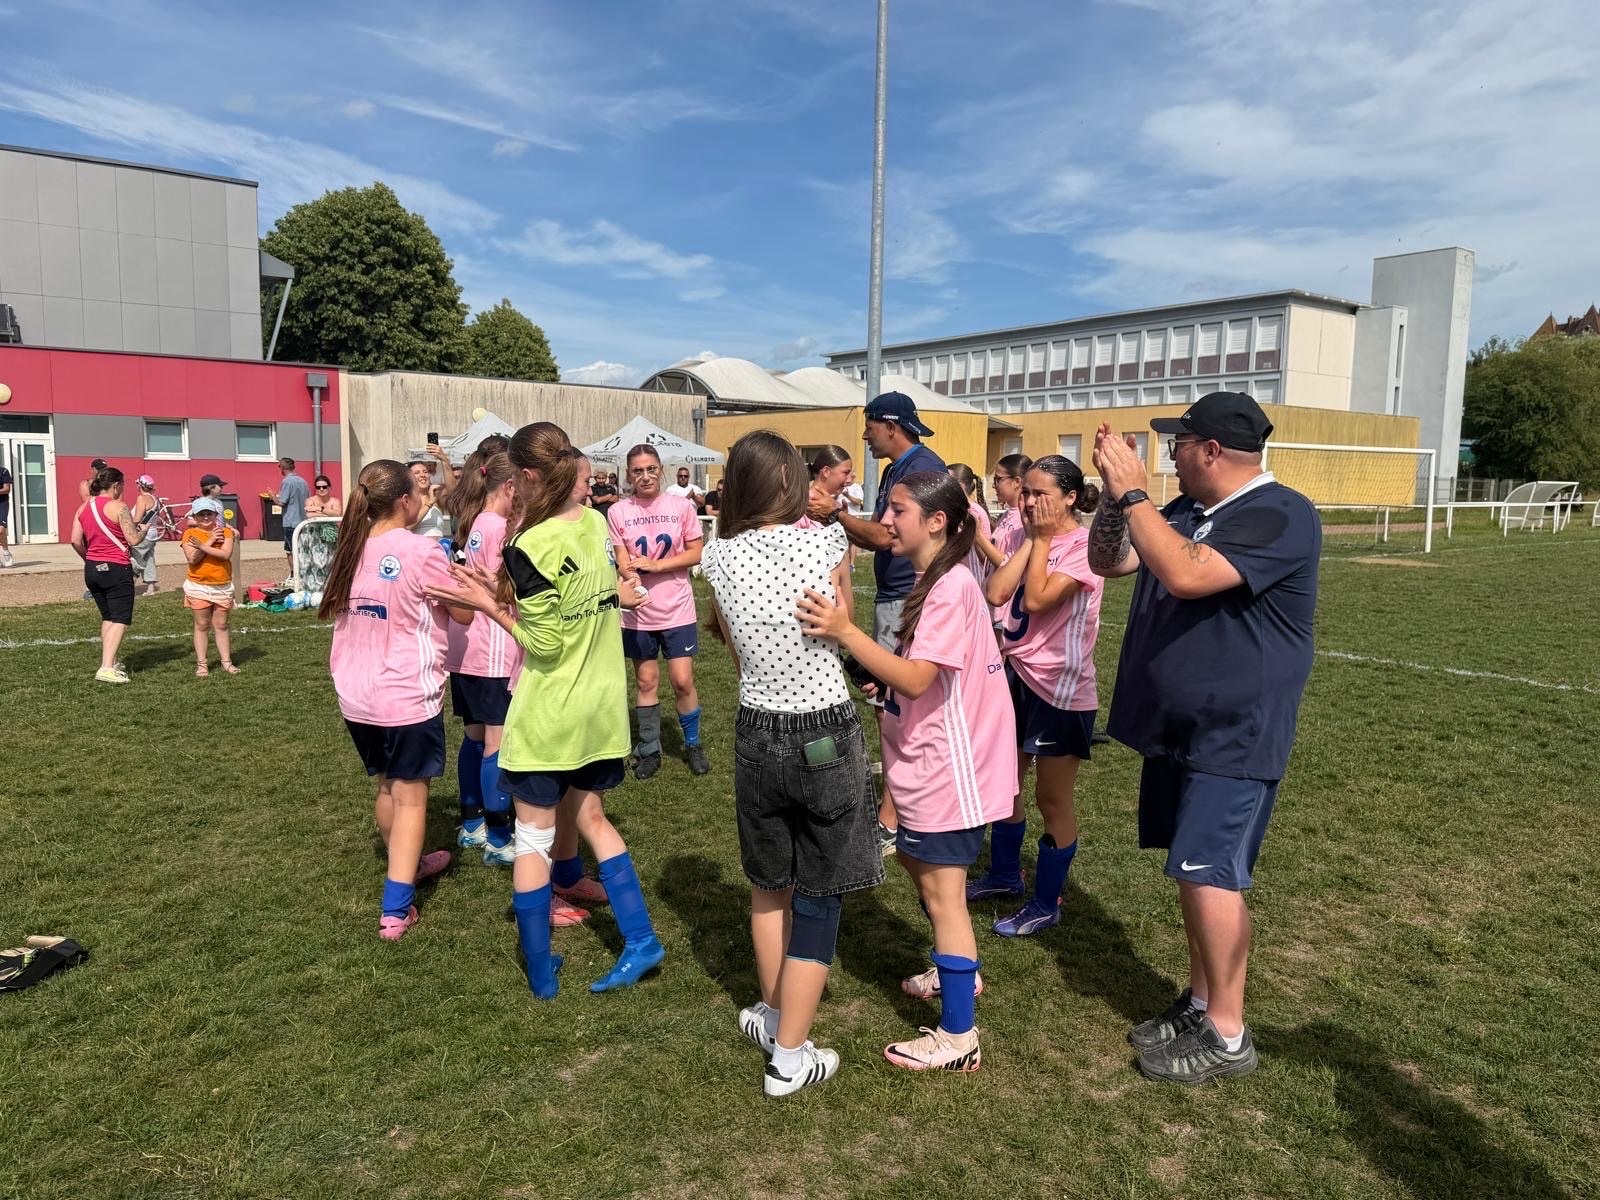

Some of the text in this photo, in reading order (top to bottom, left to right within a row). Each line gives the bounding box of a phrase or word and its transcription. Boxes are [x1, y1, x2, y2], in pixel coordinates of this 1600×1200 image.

[632, 515, 660, 526] MONTS
[660, 515, 670, 523] DE
[635, 533, 673, 561] 12
